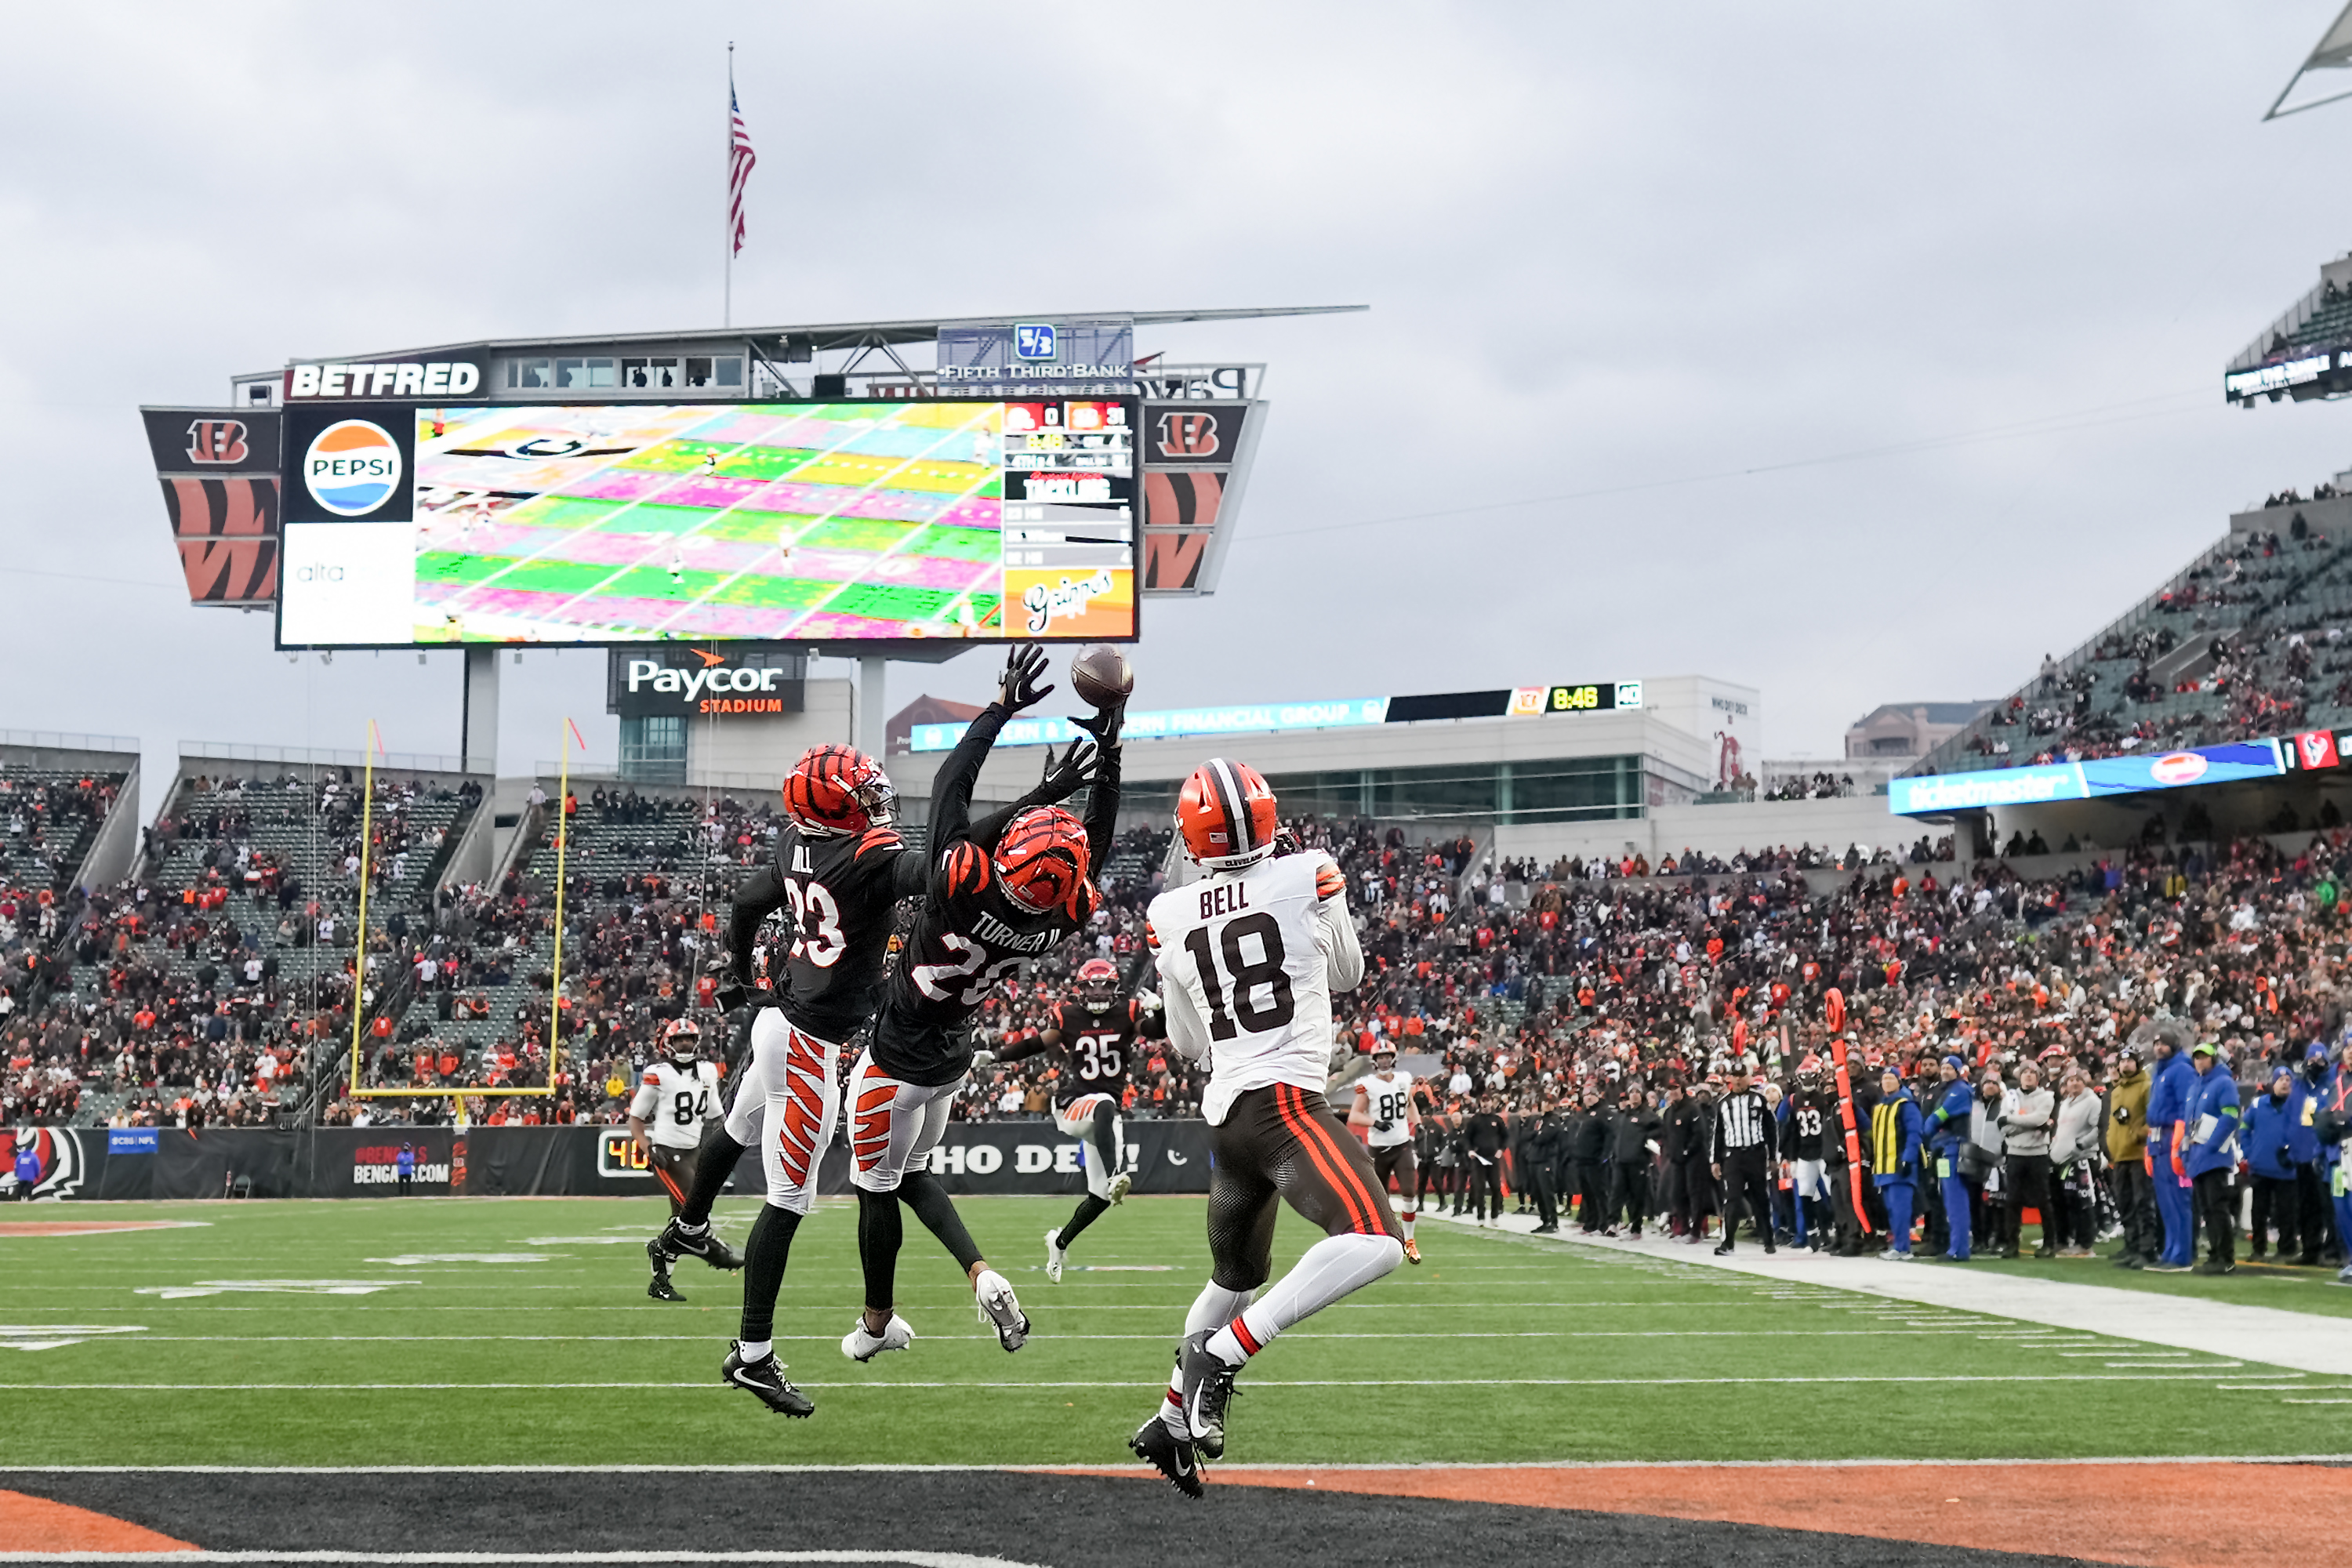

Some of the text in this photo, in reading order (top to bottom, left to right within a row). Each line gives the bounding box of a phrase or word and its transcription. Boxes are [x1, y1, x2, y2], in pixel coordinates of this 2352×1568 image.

[291, 361, 480, 397] BETFRED
[945, 363, 1127, 379] FIFTH THIRD BANK
[1044, 408, 1058, 425] 0
[1106, 407, 1126, 425] 31
[313, 459, 394, 477] PEPSI
[296, 561, 344, 583] alta
[699, 699, 782, 713] STADIUM
[1553, 686, 1599, 710] 8:46
[1618, 684, 1639, 705] 40
[1045, 721, 1058, 739] &
[1172, 708, 1276, 731] FINANCIAL
[1280, 703, 1350, 724] GROUP
[1908, 772, 2056, 811] ticketmaster
[1200, 880, 1249, 920] BELL
[971, 910, 1047, 952] TURNER
[1184, 911, 1295, 1043] 18
[1075, 1033, 1121, 1080] 35
[674, 1090, 708, 1125] 84
[1380, 1091, 1406, 1121] 88
[1796, 1109, 1822, 1137] 33
